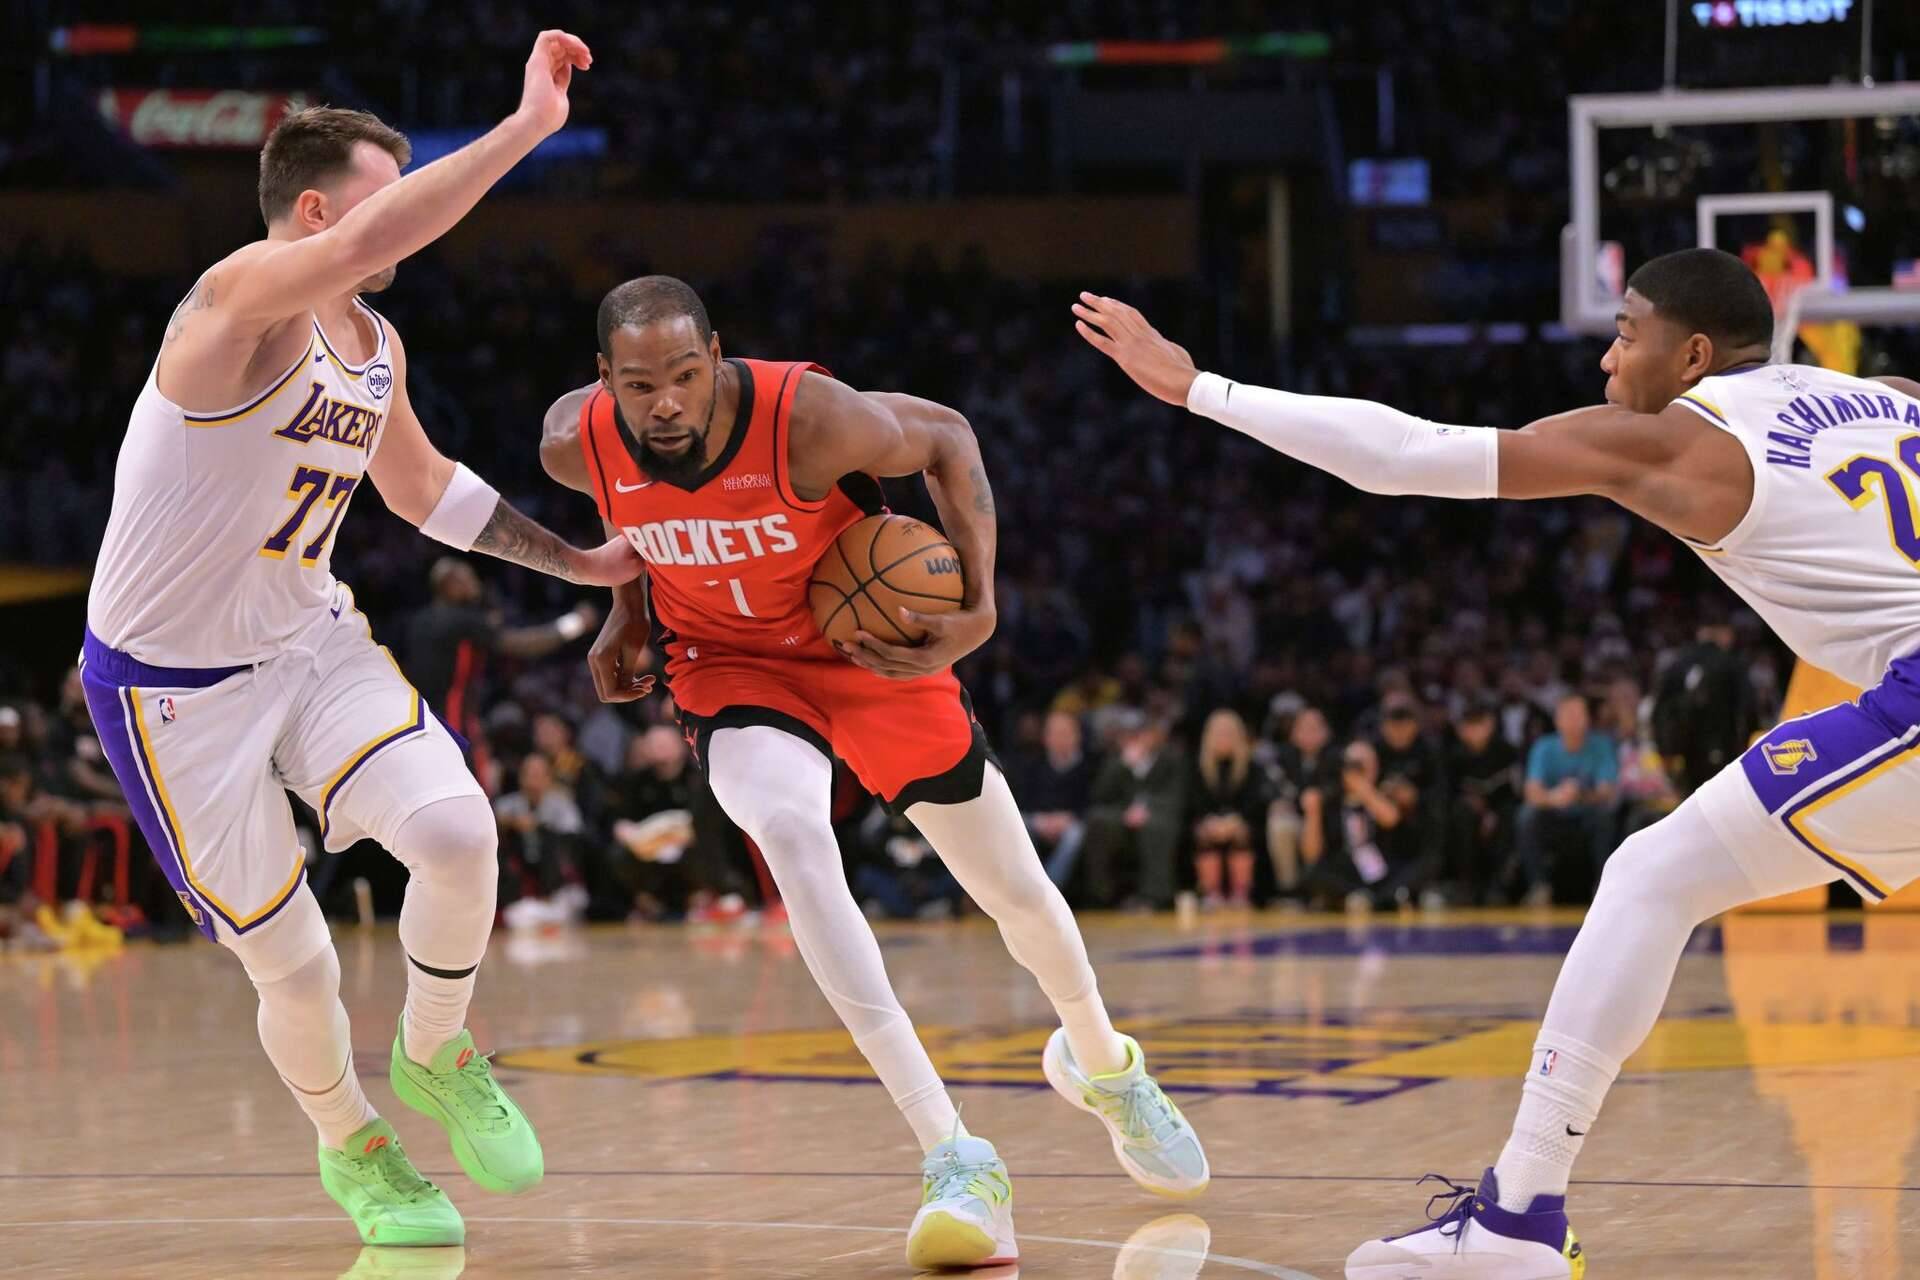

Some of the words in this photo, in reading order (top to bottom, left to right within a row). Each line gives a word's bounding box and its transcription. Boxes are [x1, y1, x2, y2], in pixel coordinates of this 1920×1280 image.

[1766, 393, 1920, 469] HACHIMURA
[258, 463, 361, 568] 77
[622, 513, 799, 566] ROCKETS
[1823, 431, 1920, 577] 2
